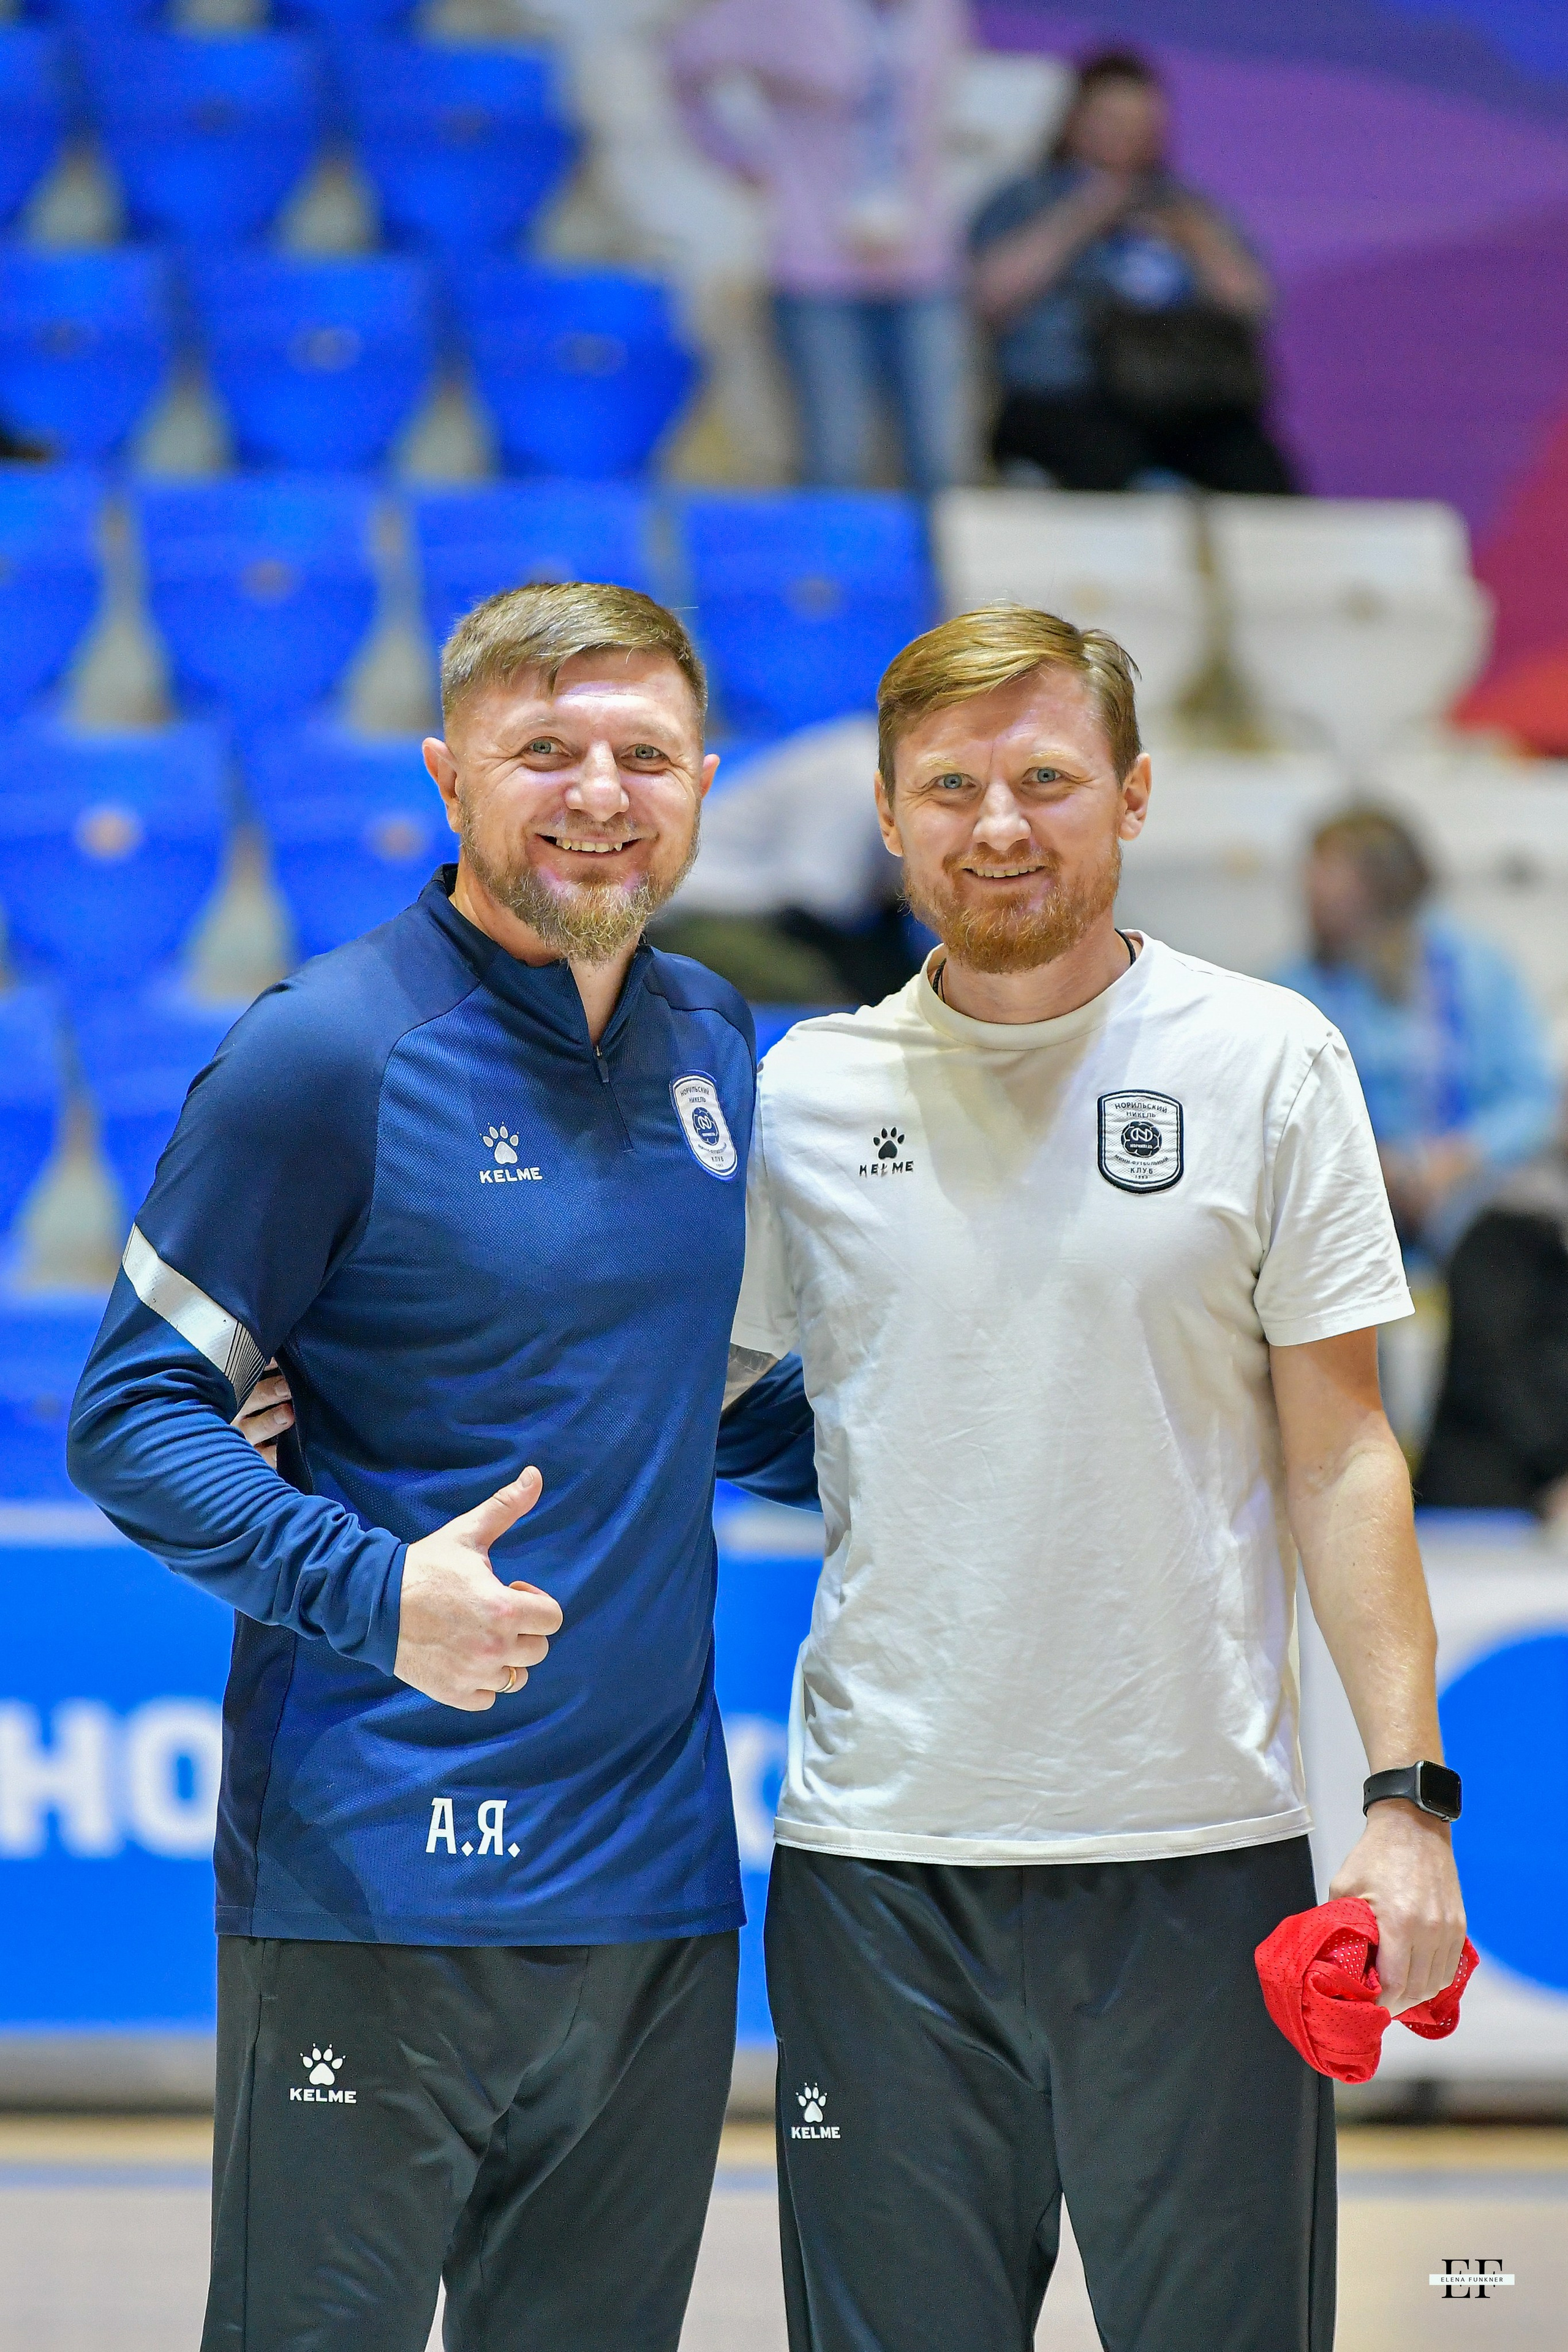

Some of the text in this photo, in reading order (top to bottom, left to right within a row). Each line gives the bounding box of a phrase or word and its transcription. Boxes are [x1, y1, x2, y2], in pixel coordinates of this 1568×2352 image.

[1114, 1102, 1167, 1114] НОРИЛЬСКИЙ
[479, 1167, 543, 1183] KELME
[859, 1161, 914, 1178] KELME
[426, 1798, 521, 1858] А.Я.
[290, 2088, 357, 2104] KELME
[791, 2127, 841, 2139] KELME
